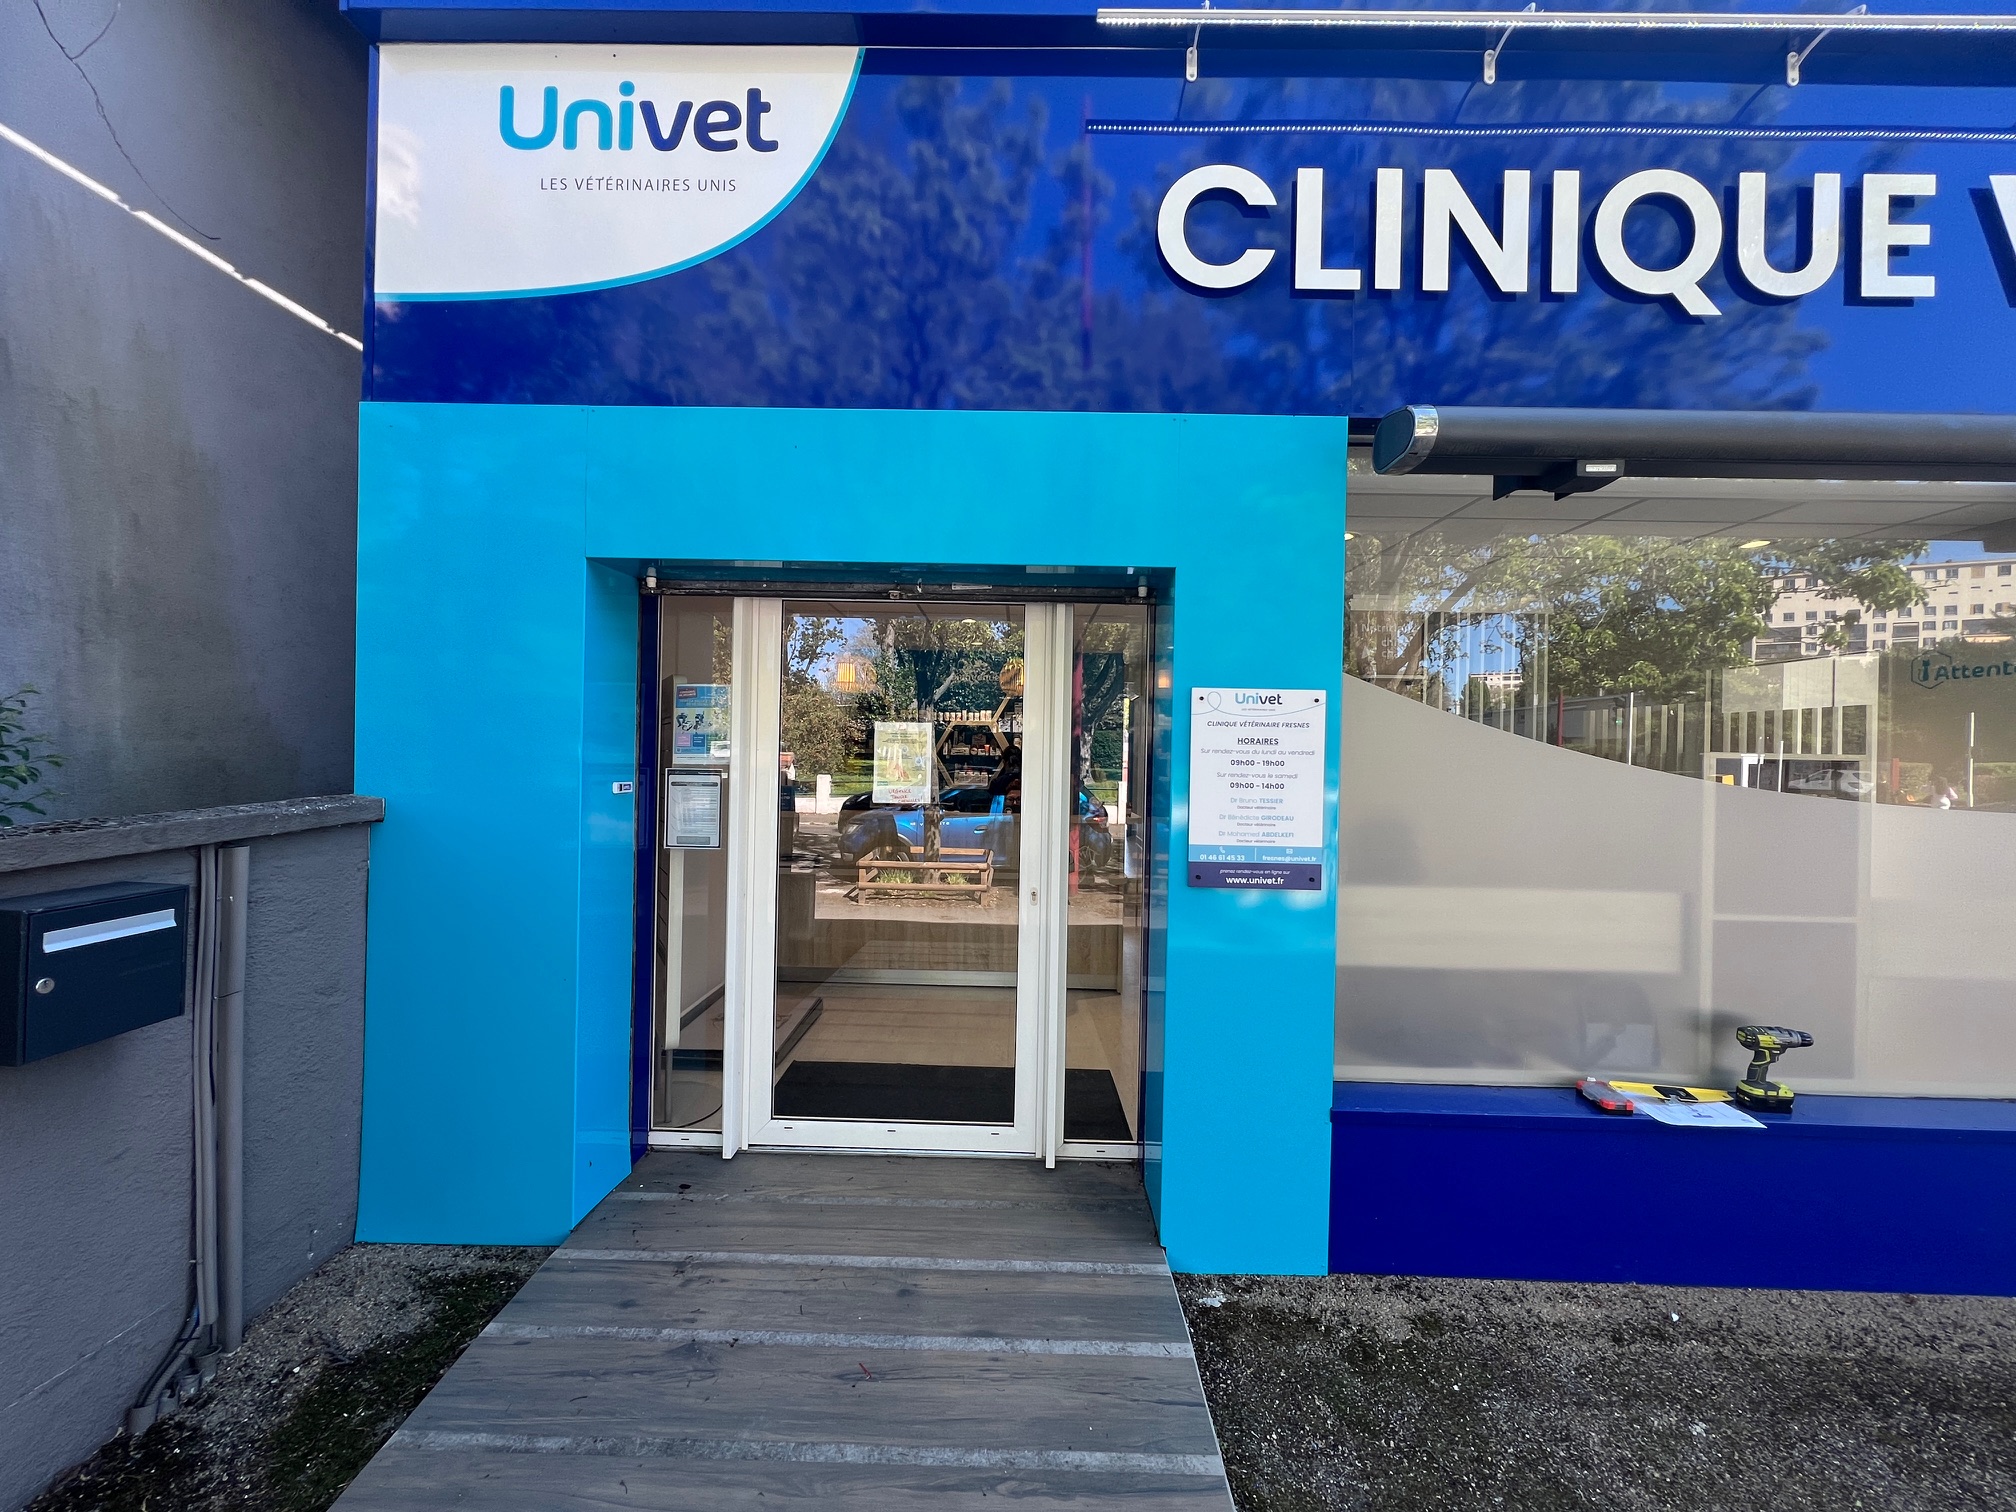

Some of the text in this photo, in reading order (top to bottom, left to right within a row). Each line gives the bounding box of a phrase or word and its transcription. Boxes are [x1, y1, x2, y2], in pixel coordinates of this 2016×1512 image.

[499, 80, 779, 153] Univet
[540, 176, 737, 192] LES VÉTÉRINAIRES UNIS
[1157, 164, 1936, 316] CLINIQUE
[1235, 693, 1282, 705] Univet
